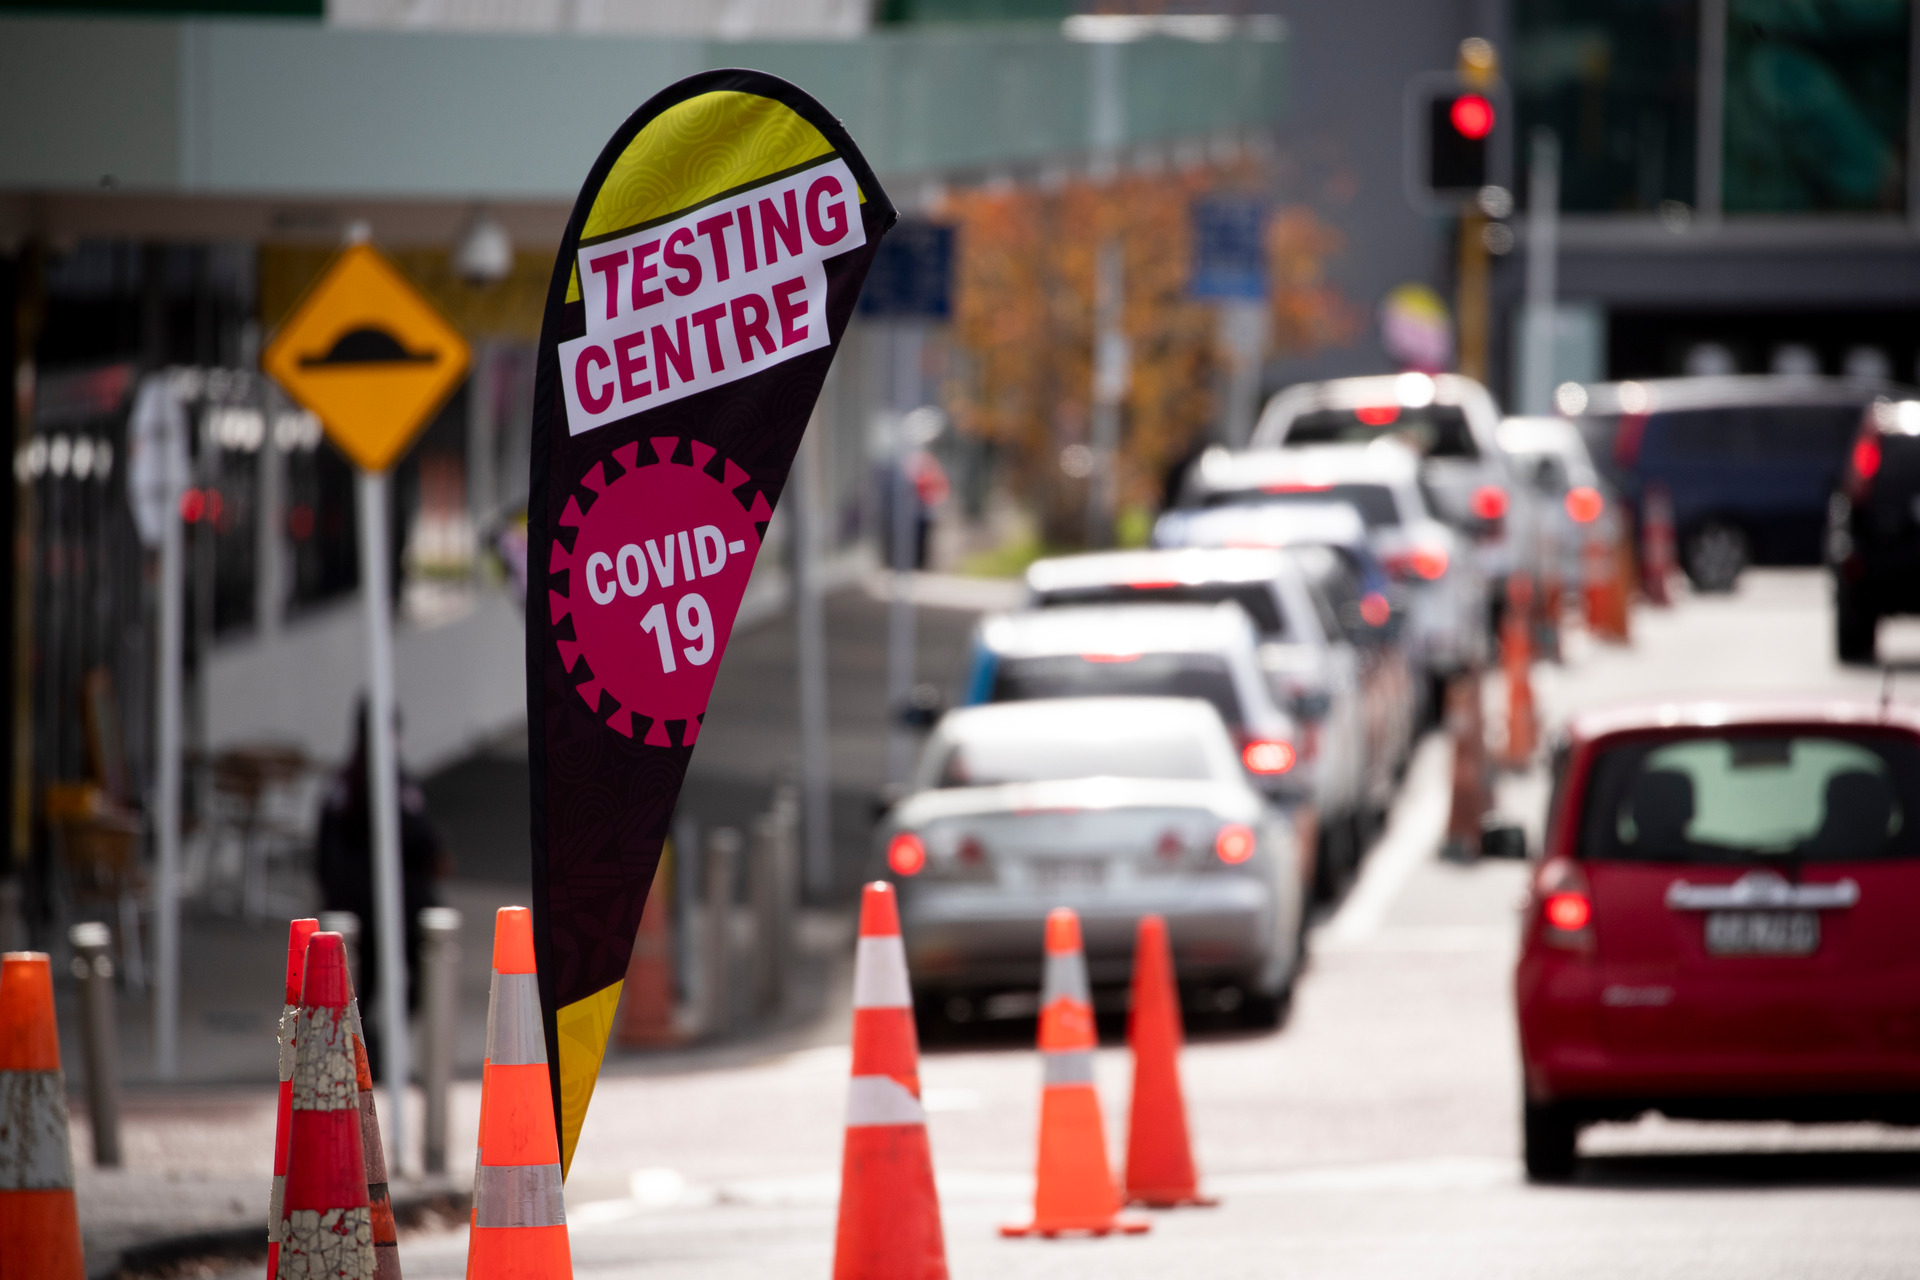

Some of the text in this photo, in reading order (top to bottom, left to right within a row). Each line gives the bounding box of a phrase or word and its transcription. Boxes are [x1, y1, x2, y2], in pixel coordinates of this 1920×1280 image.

[590, 175, 850, 320] TESTING
[575, 275, 809, 415] CENTRE
[585, 524, 746, 605] COVID-
[639, 593, 715, 674] 19
